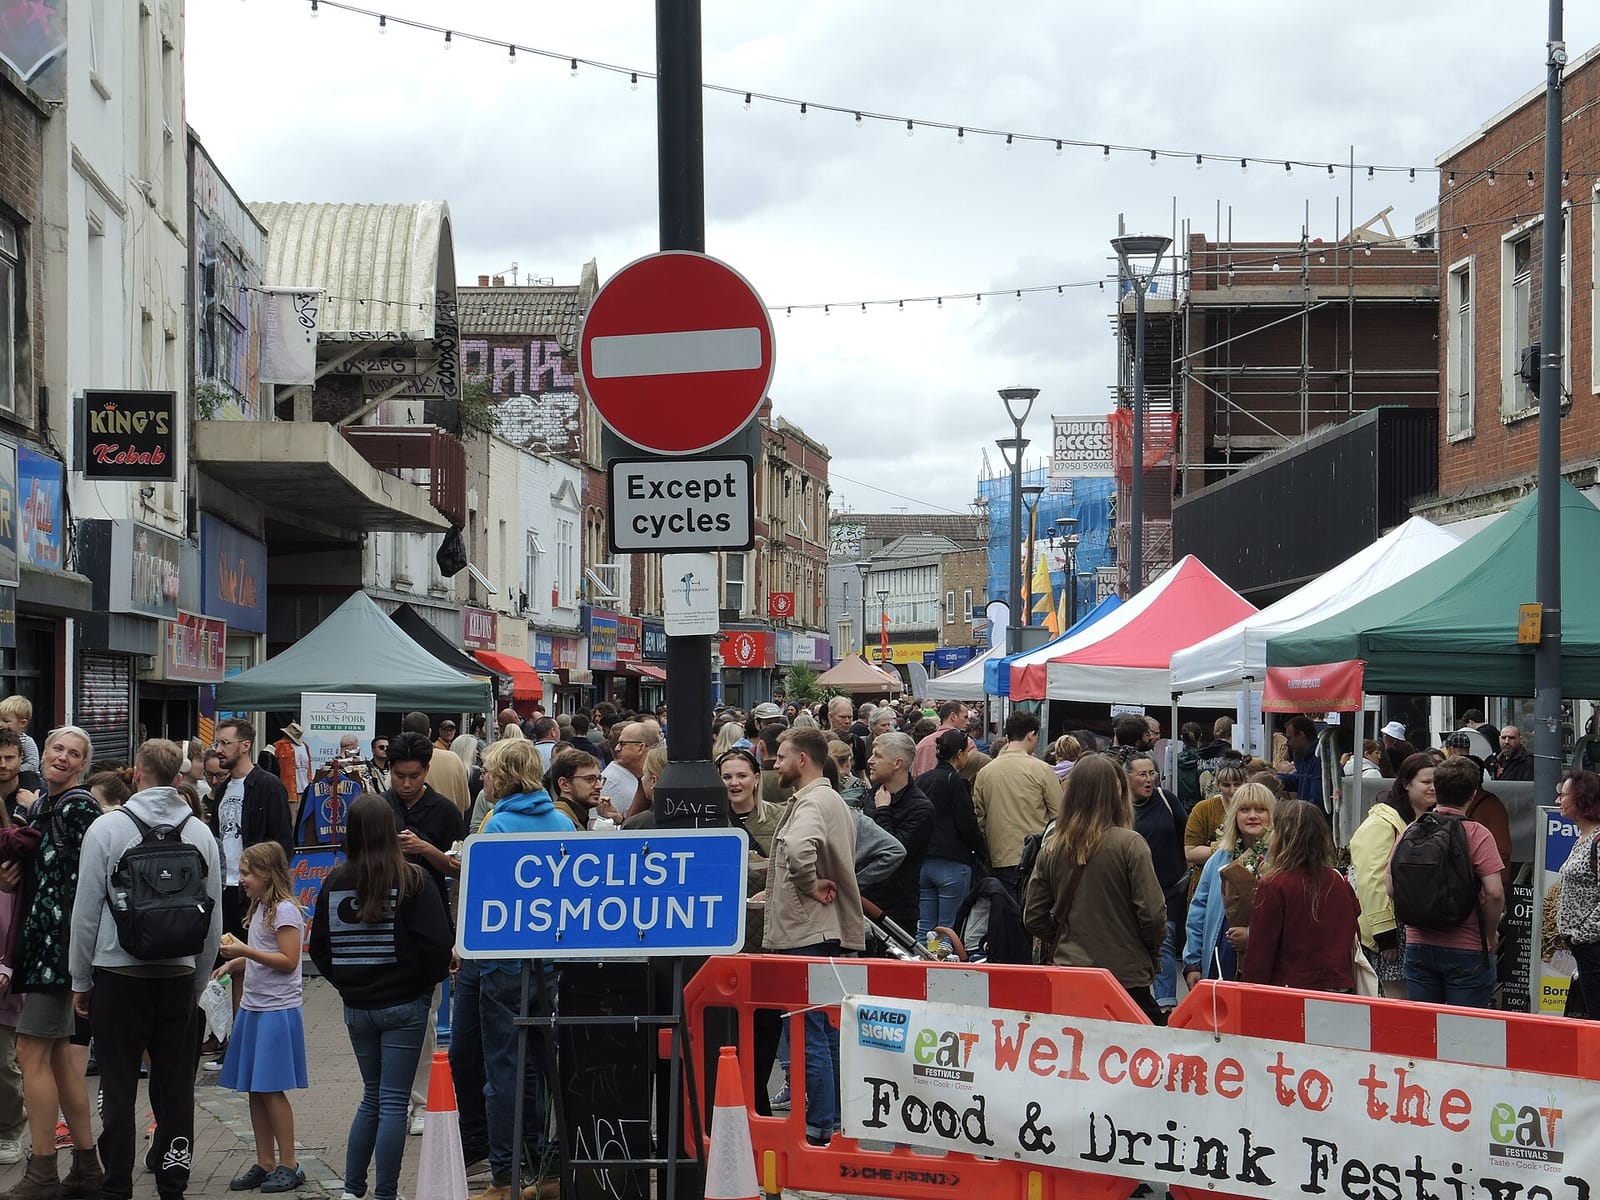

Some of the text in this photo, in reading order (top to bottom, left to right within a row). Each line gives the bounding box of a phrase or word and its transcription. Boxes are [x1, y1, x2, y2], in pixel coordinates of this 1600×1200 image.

[89, 410, 169, 435] KING'S
[1055, 422, 1112, 435] TUBULAR
[1055, 436, 1113, 450] ACCESS
[93, 443, 166, 466] Kebab
[1055, 450, 1113, 461] SCAFFOLDS
[1054, 462, 1081, 471] 07950
[627, 473, 737, 503] Except
[632, 507, 731, 539] cycles
[310, 714, 366, 723] MIKE'S PORK
[319, 748, 334, 756] FREE
[664, 799, 717, 819] DAVE
[514, 851, 695, 889] CYCLIST
[480, 895, 723, 933] DISMOUNT
[859, 1008, 907, 1025] NAKED
[861, 1023, 904, 1042] SIGNS
[925, 1067, 961, 1080] FESTIVALS
[992, 1019, 1473, 1133] Welcome to the
[862, 1076, 995, 1147] Food
[1018, 1101, 1056, 1155] &
[1080, 1111, 1277, 1186] Drink
[1505, 1147, 1548, 1160] FESTIVALS
[1489, 1157, 1562, 1174] Taste Cook Grow
